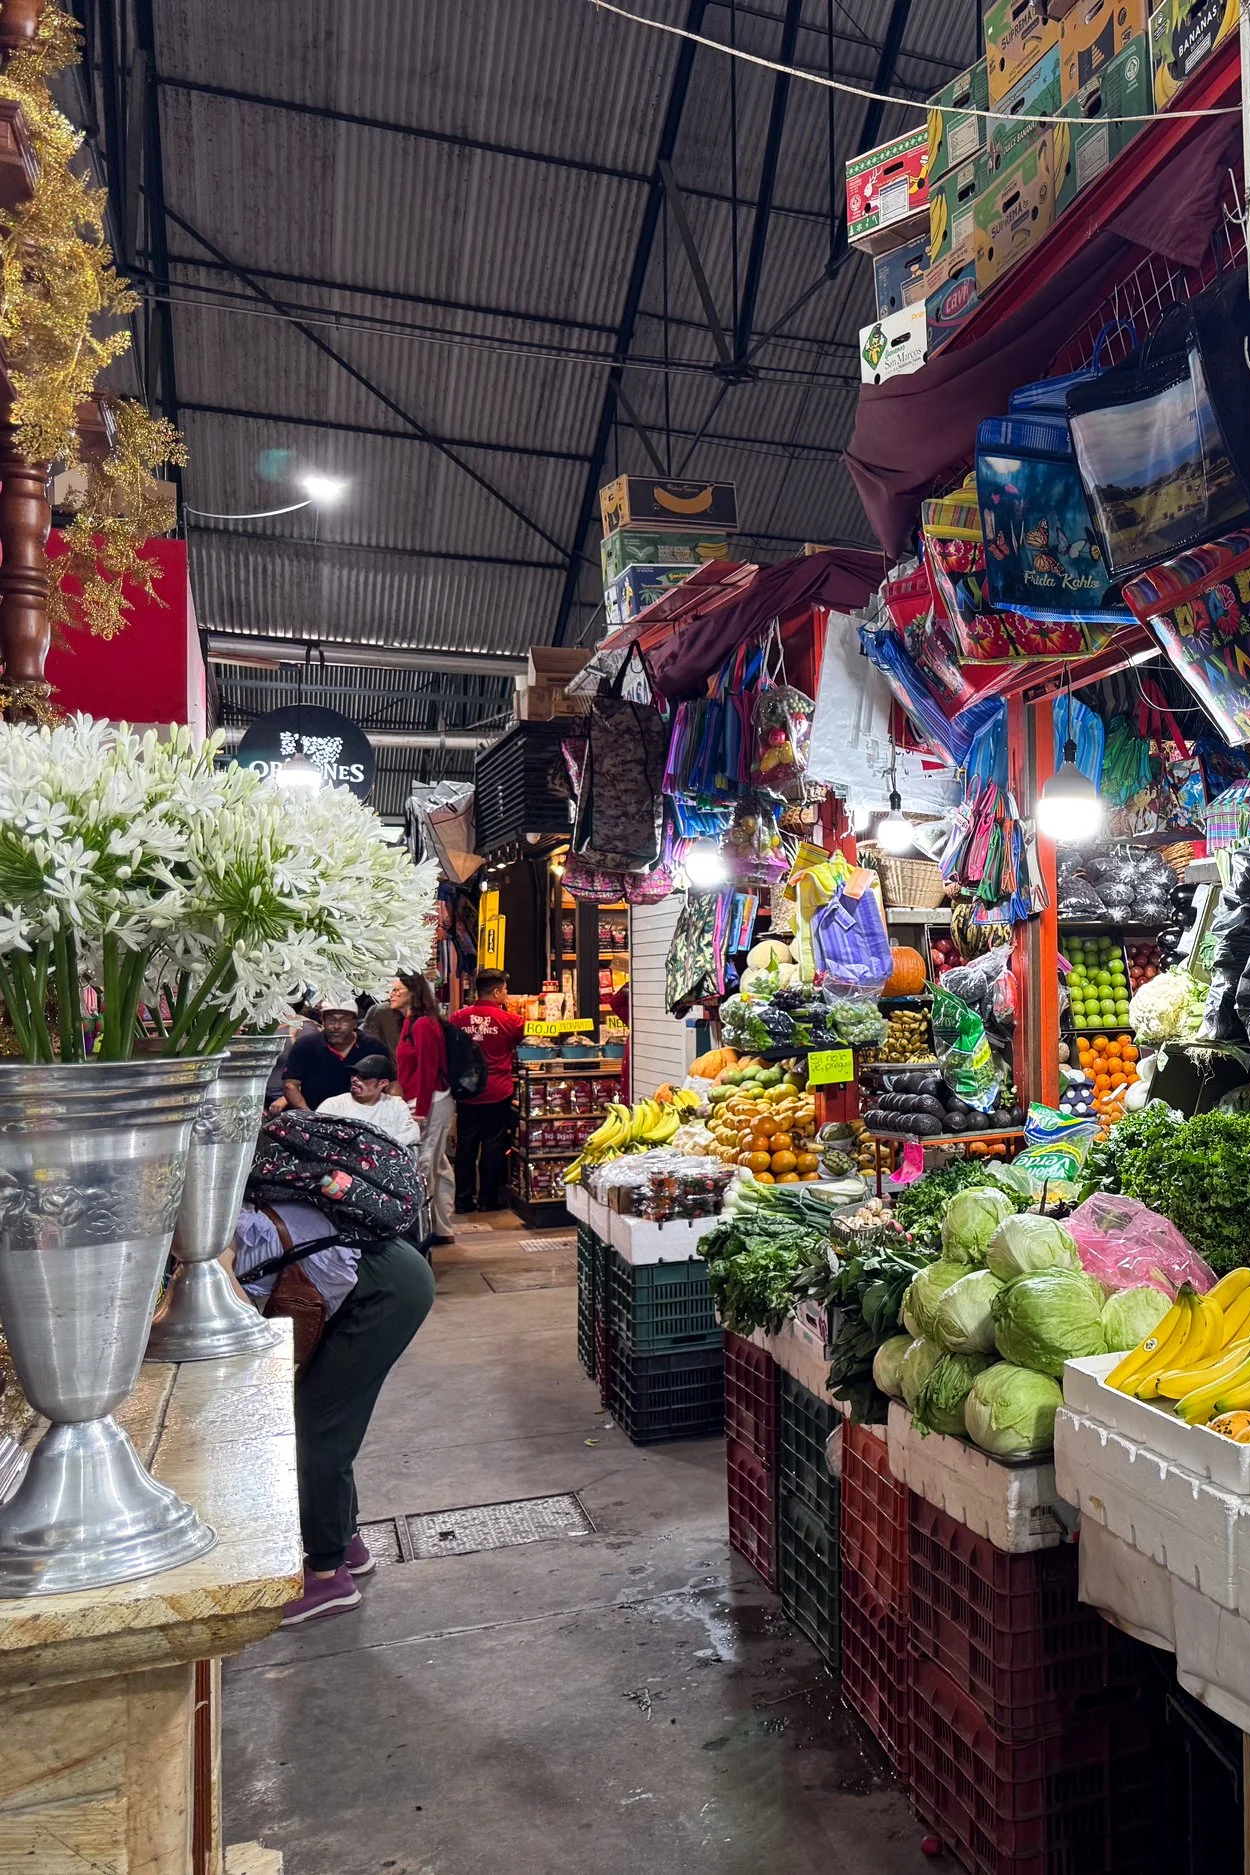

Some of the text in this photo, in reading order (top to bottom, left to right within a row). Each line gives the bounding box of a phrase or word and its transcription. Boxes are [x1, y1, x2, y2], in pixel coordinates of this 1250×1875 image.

[1179, 5, 1217, 57] BANANAS
[1024, 570, 1100, 591] Frida Kahlo
[249, 760, 365, 783] ORNES
[527, 1022, 557, 1035] ROJO
[1015, 1156, 1069, 1170] Verde
